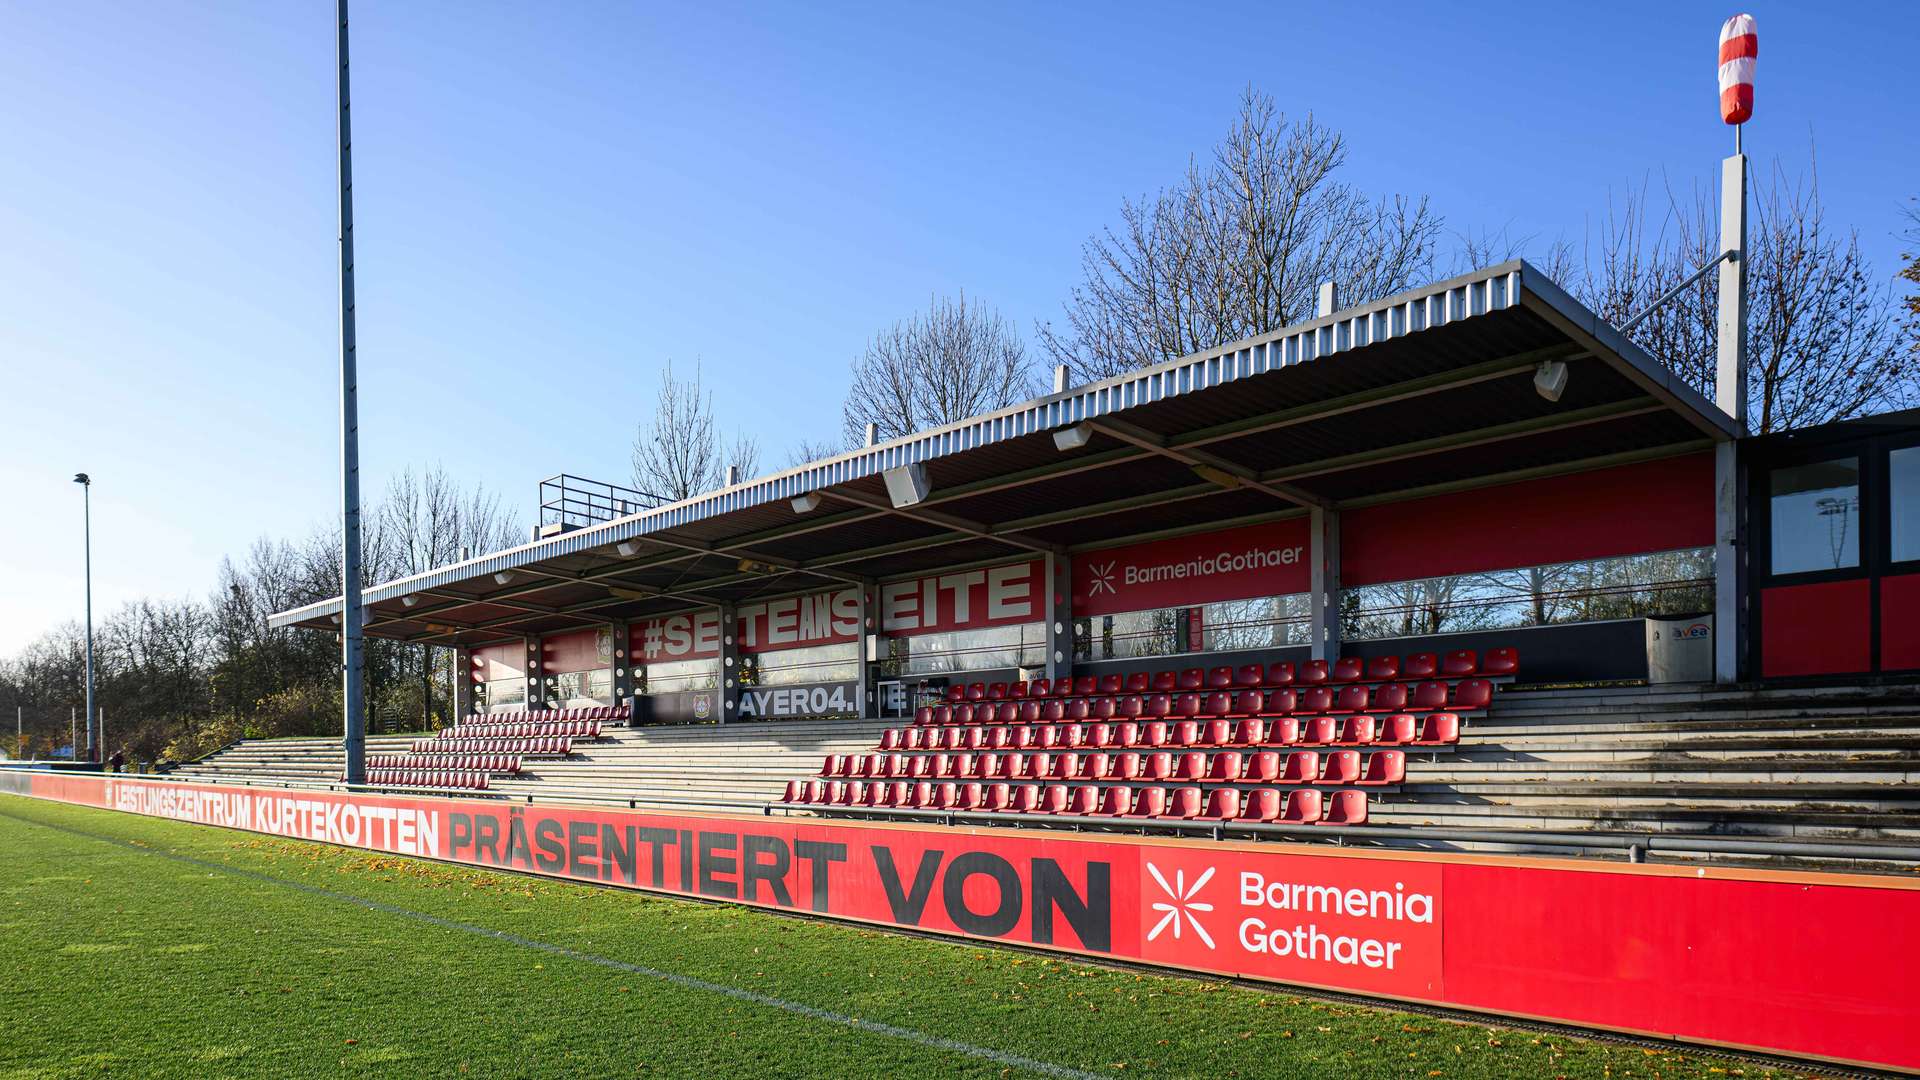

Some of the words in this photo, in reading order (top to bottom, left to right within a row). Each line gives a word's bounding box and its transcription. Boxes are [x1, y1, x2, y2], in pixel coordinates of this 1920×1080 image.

[1125, 546, 1303, 585] BarmeniaGothaer
[115, 783, 250, 828] LEISTUNGSZENTRUM
[255, 795, 439, 857] KURTEKOTTEN
[448, 806, 848, 913] PRÄSENTIERT
[870, 845, 1111, 953] VON
[1240, 871, 1433, 924] Barmenia
[1238, 917, 1402, 970] Gothaer
